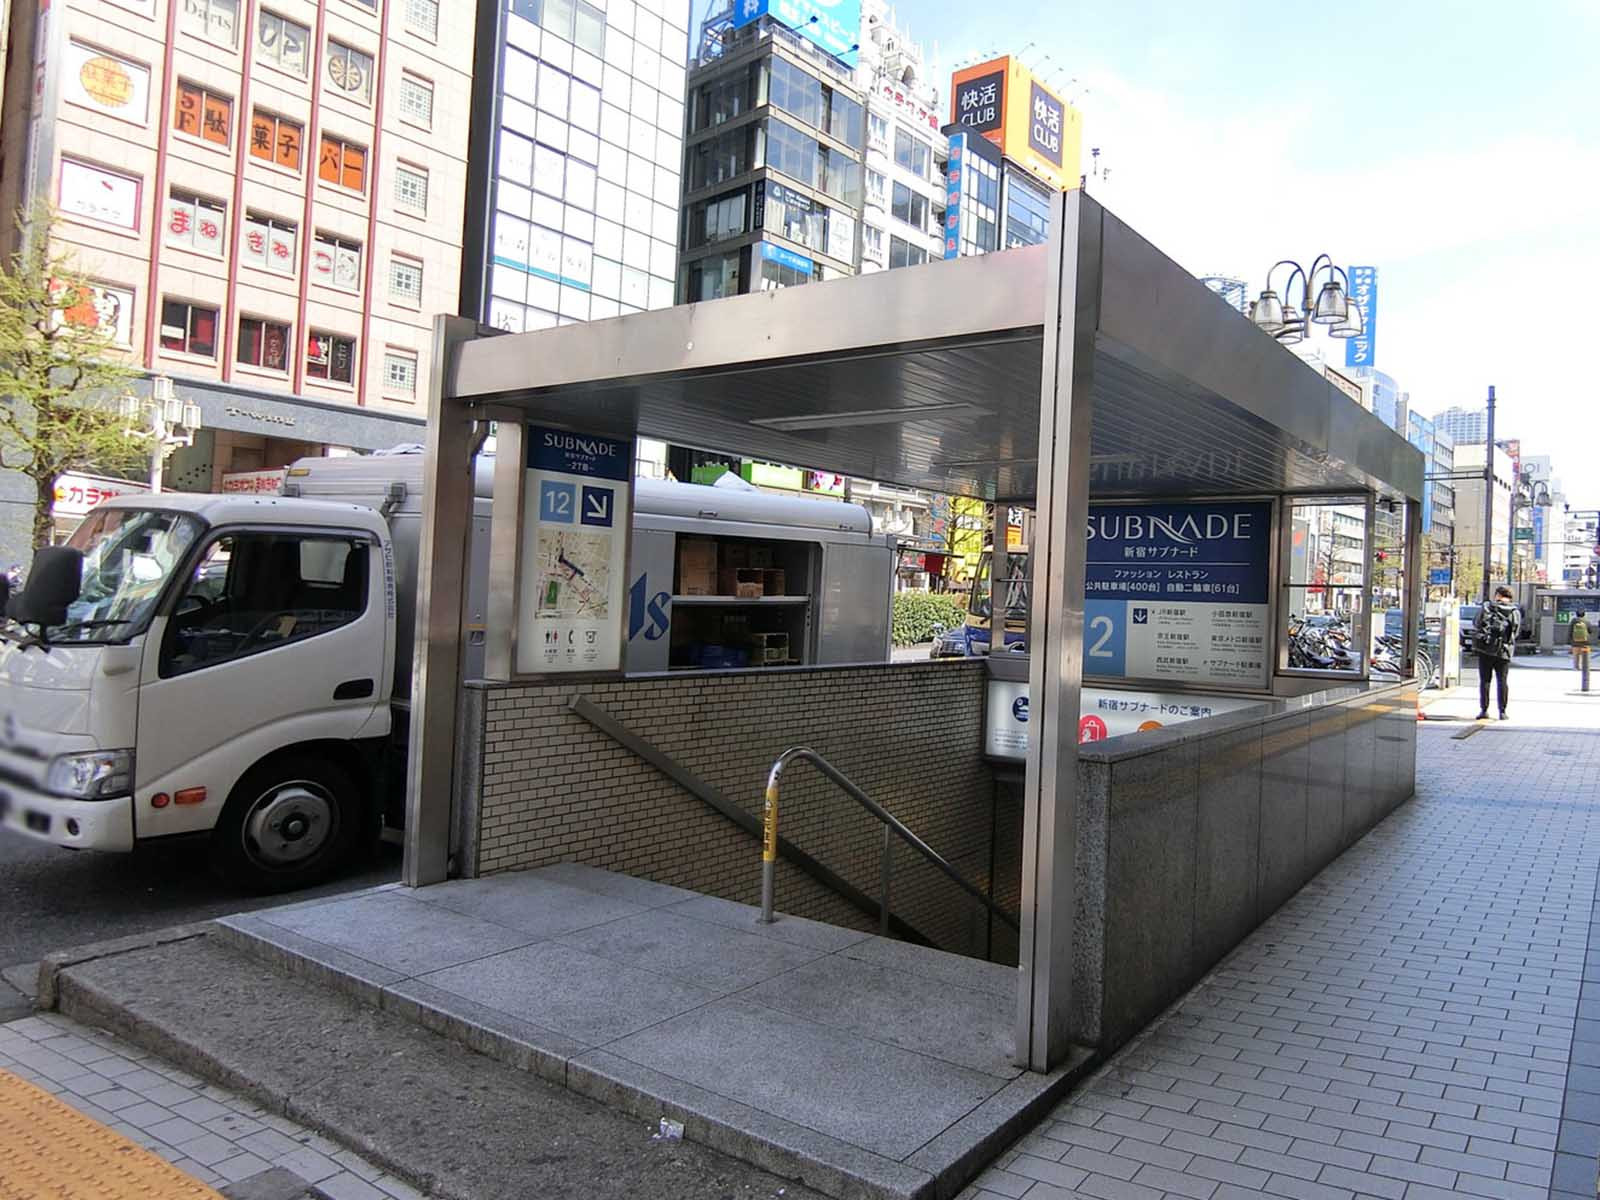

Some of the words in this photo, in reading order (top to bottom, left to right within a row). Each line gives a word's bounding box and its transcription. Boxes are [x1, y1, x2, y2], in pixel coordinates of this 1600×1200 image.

[961, 83, 996, 111] 快活
[961, 107, 995, 127] CLUB
[1034, 95, 1060, 134] 快活
[1033, 124, 1059, 153] CLUB
[544, 432, 616, 456] SUBNADE
[546, 490, 570, 515] 12
[1086, 513, 1252, 544] SUBNADE
[1124, 546, 1198, 558] 新宿サブナード
[1114, 569, 1162, 579] ファッション
[1168, 570, 1209, 580] レストラン
[1089, 615, 1114, 657] 2
